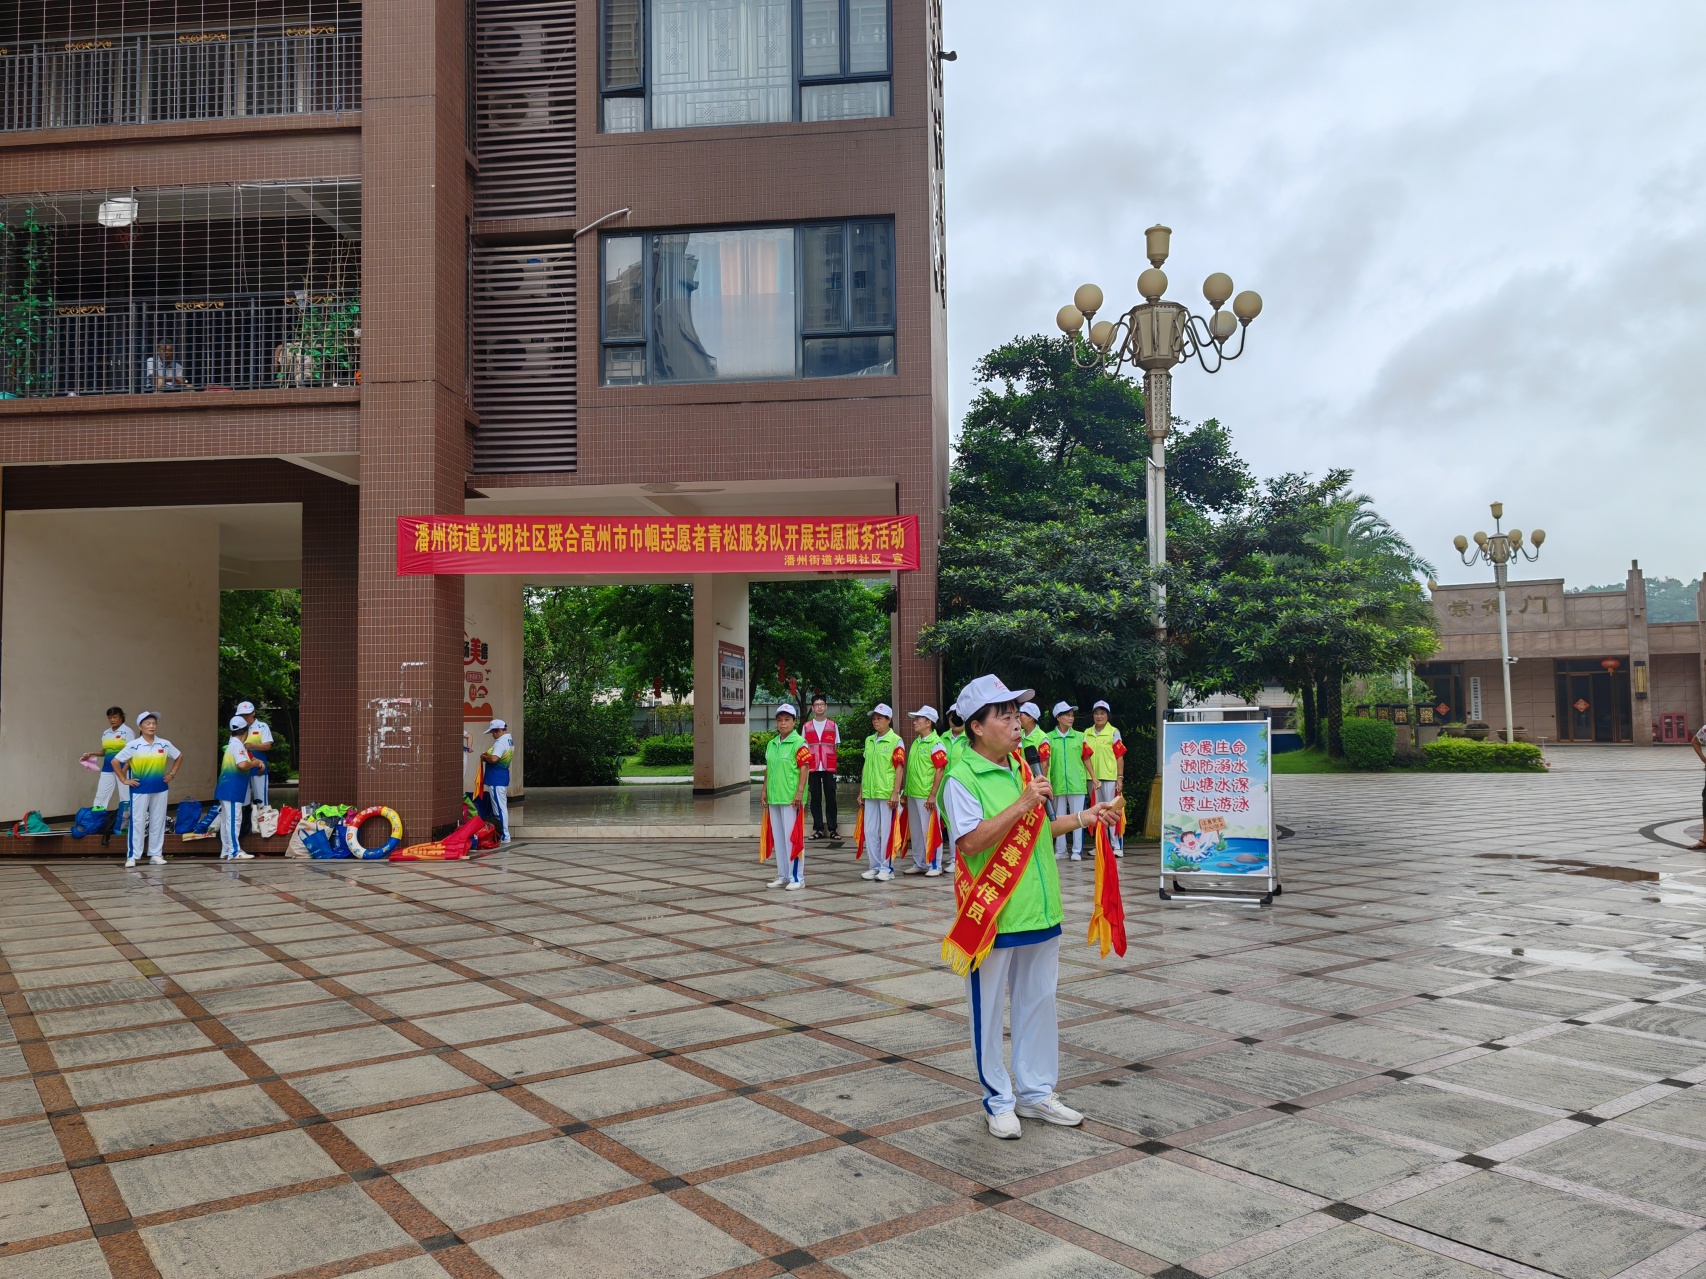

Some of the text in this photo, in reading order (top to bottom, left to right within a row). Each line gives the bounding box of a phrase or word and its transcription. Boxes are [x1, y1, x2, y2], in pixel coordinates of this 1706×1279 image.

[415, 522, 904, 553] 潘州街道光明社区联合高州市巾帼志愿者青松服务队开展志愿服务活动
[784, 554, 882, 566] 潘州街道光明社区
[1182, 740, 1247, 755] 珍爱生命
[1182, 759, 1248, 773] 预防溺水
[1181, 777, 1249, 792] 山塘水深
[1180, 796, 1249, 812] 禁止游泳
[966, 803, 1042, 925] 市禁毒宣传员
